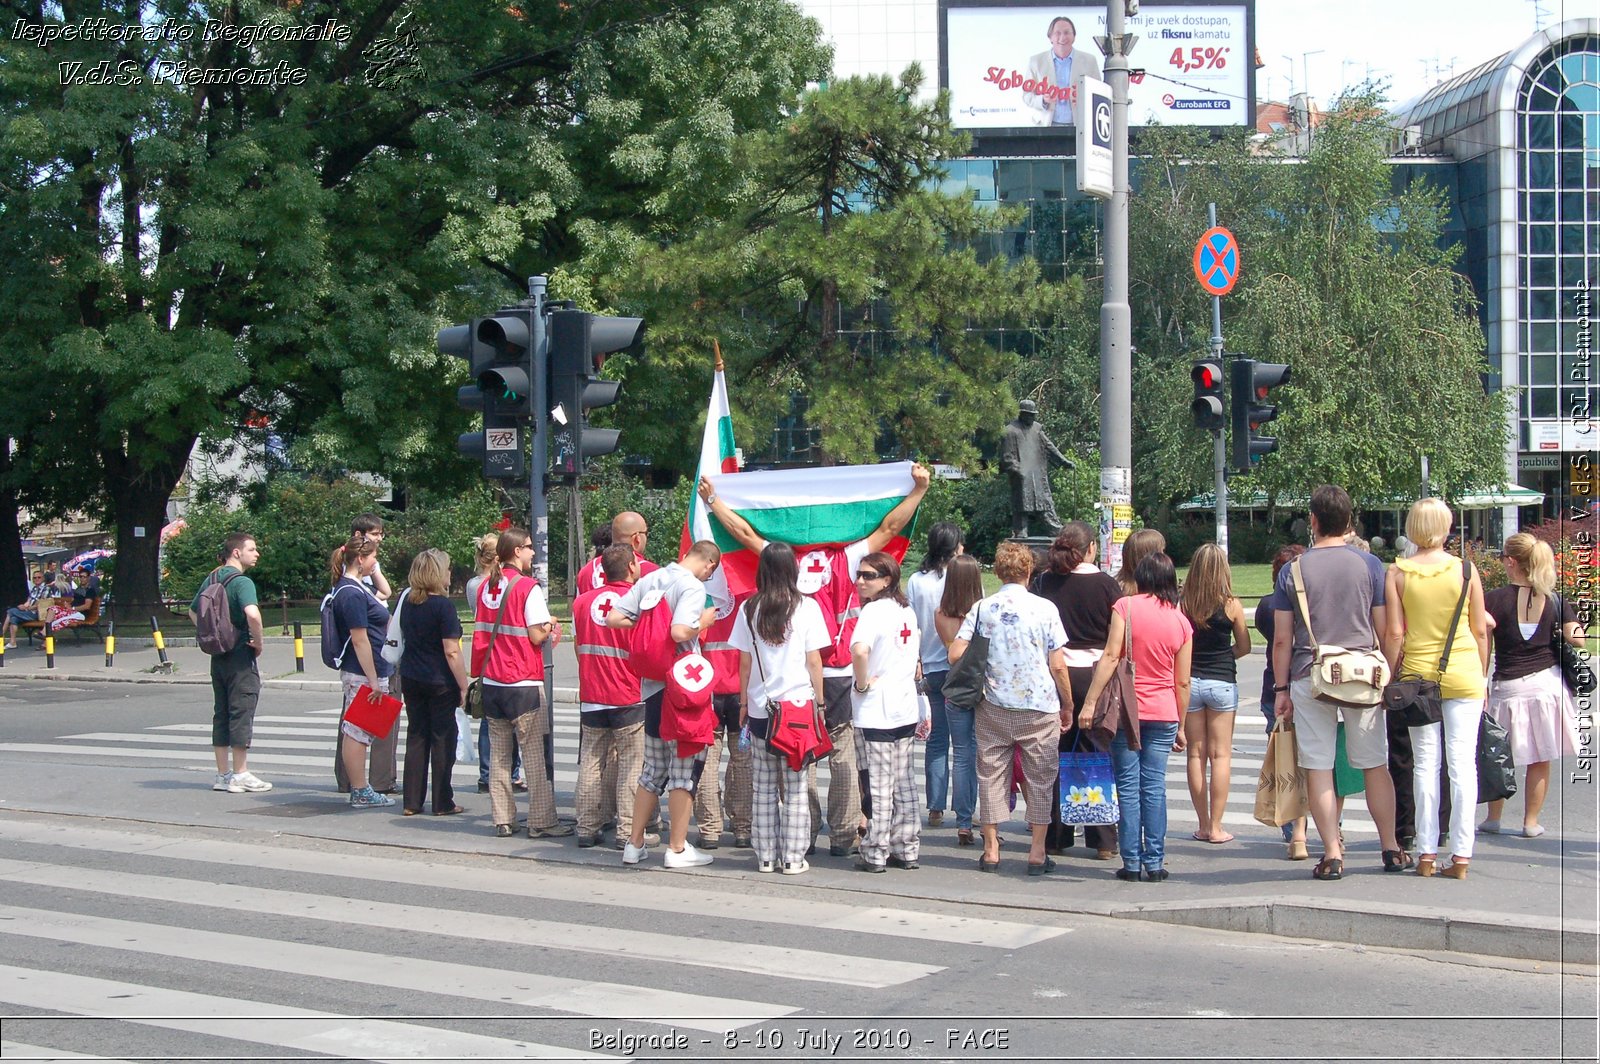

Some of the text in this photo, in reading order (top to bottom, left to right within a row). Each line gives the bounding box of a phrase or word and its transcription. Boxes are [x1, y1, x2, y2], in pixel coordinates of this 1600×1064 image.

[1145, 15, 1154, 27] je
[1157, 15, 1180, 25] uvek
[1183, 15, 1231, 27] dostupan,
[1148, 28, 1230, 39] uz fiksnu kamatu
[1176, 100, 1227, 109] Eurobank EFG
[1517, 456, 1559, 468] epublike
